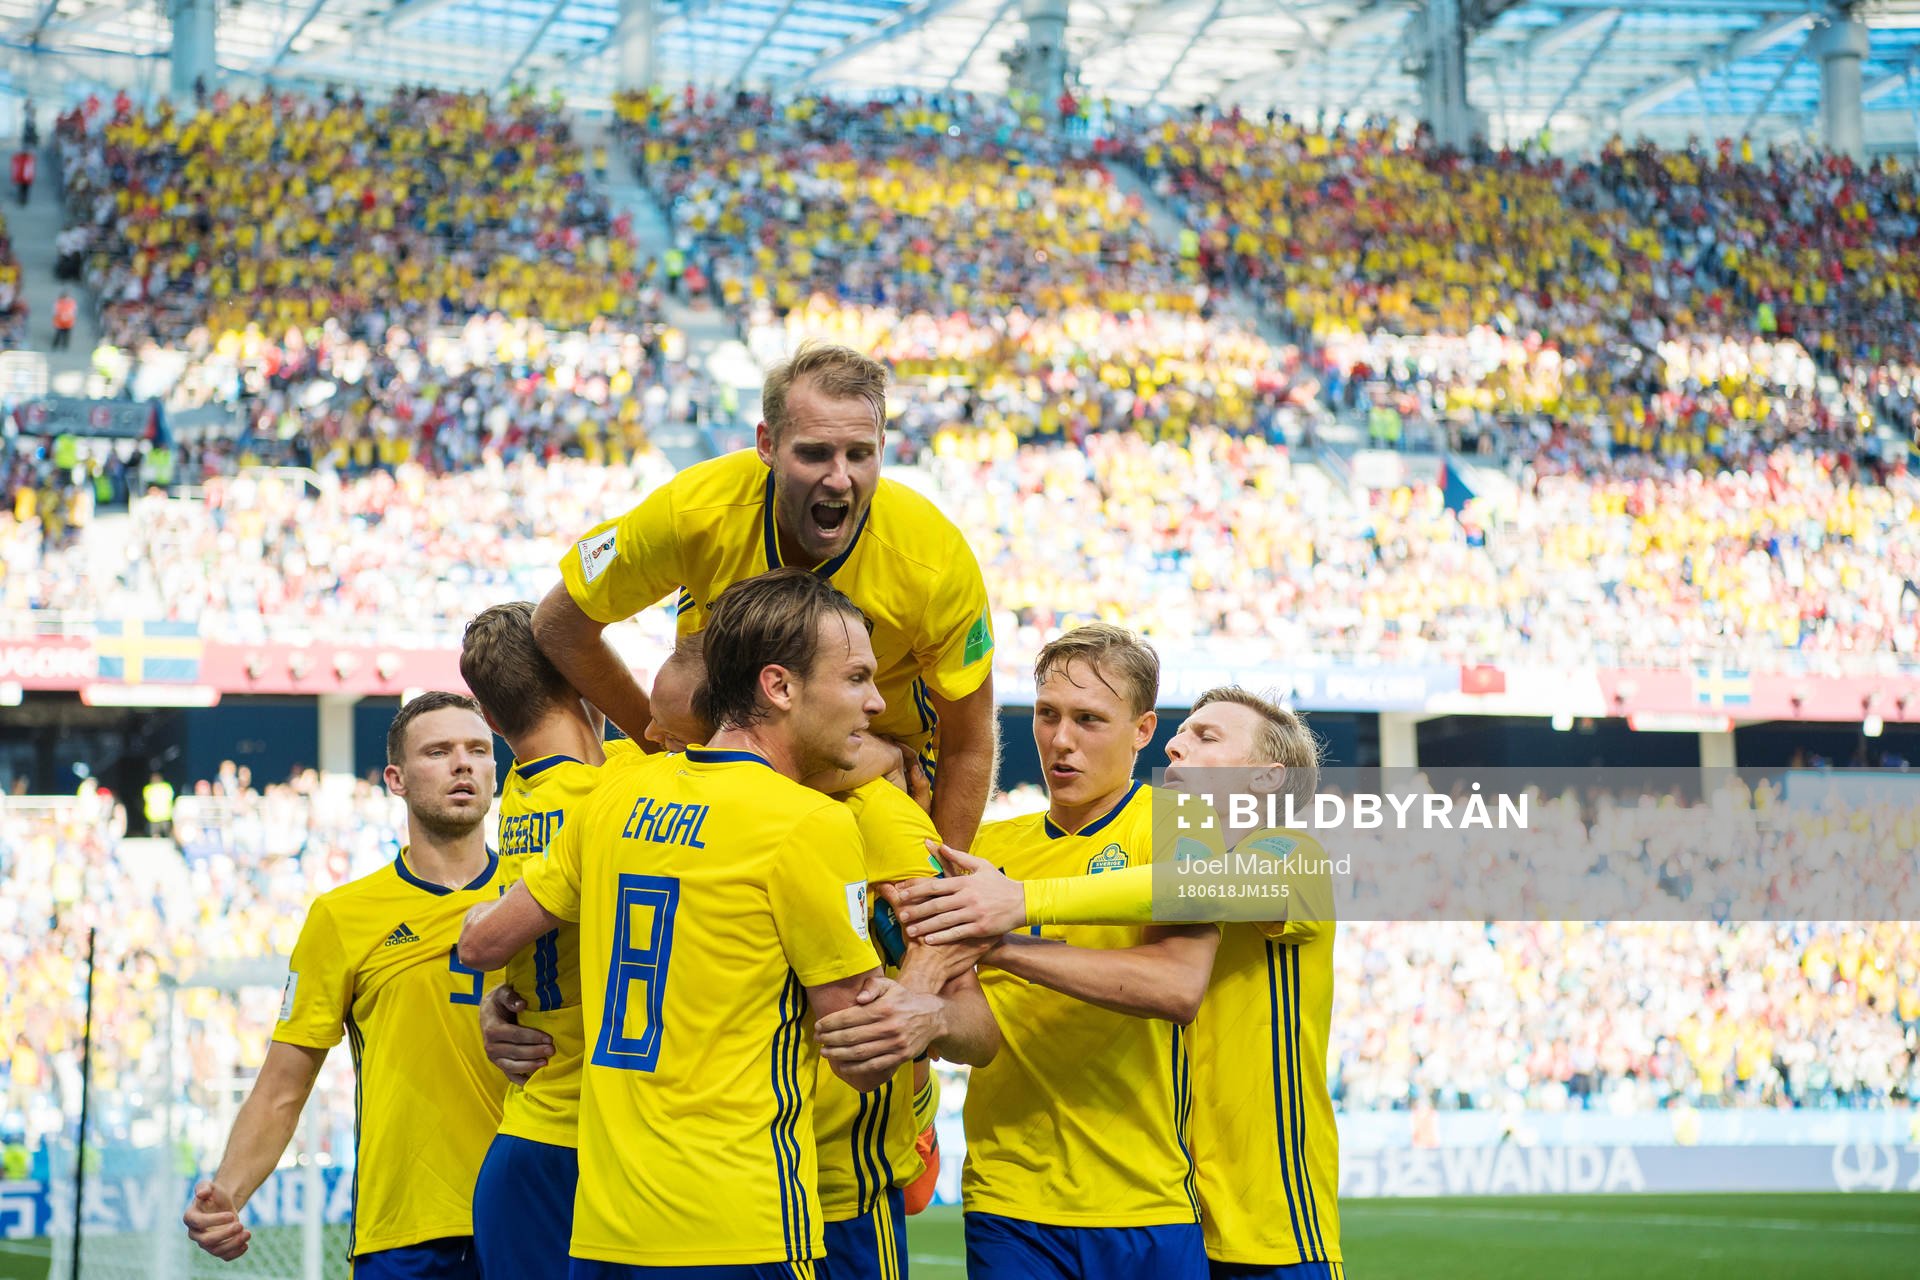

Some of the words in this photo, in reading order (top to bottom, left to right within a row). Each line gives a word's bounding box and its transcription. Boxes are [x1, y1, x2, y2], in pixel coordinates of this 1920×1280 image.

[622, 797, 709, 849] EKDAL
[384, 934, 421, 947] adidas
[449, 943, 485, 1006] 5
[591, 873, 680, 1073] 8
[1441, 1145, 1646, 1195] WANDA
